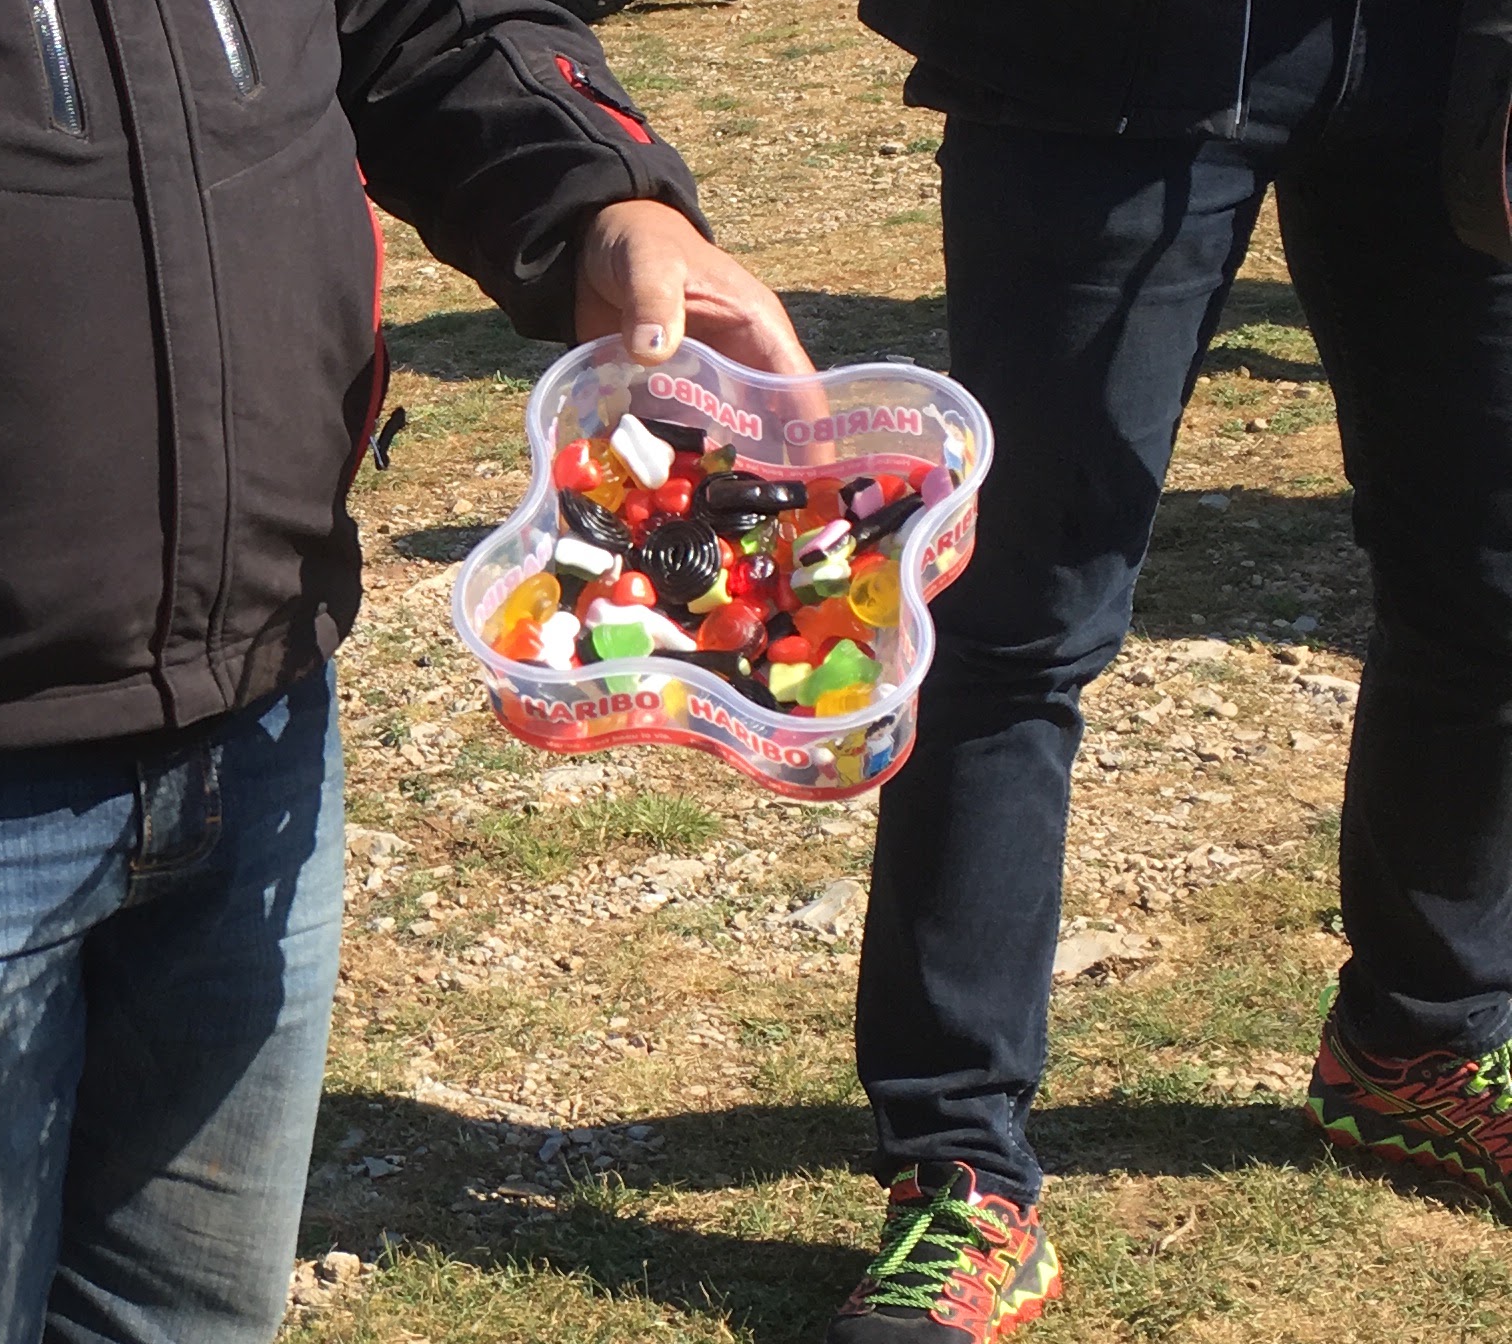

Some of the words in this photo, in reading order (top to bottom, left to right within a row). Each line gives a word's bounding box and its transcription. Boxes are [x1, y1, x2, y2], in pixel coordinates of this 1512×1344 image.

[920, 504, 977, 574] ARIB
[521, 690, 661, 723] HARIBO
[688, 694, 813, 769] HARIBO
